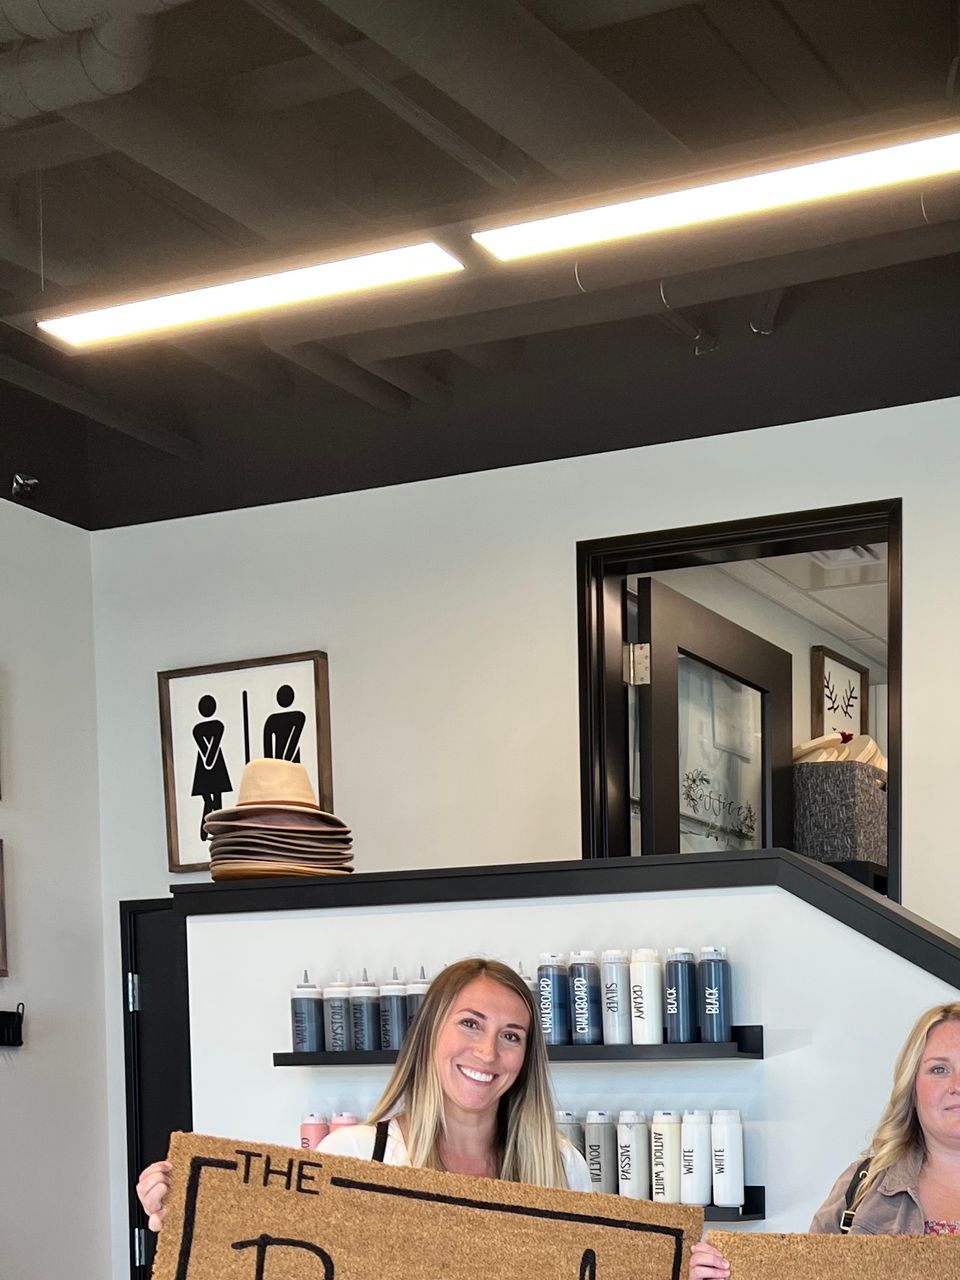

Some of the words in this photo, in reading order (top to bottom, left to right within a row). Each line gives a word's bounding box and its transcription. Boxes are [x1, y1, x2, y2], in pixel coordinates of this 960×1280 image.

[540, 977, 553, 1033] CHALKBOARD
[574, 977, 588, 1033] CHALKBOARD
[605, 982, 619, 1013] SILVER
[632, 984, 645, 1020] CREAMY
[666, 986, 678, 1014] BLACK
[705, 986, 719, 1014] BLACK
[295, 1011, 308, 1045] WALNUT
[351, 1003, 365, 1051] PROVINCIAL
[381, 1008, 391, 1048] GRAPHITE
[619, 1143, 632, 1180] PASSIVE
[653, 1132, 665, 1167] ANTIQUE
[683, 1148, 694, 1175] WHITE
[714, 1148, 725, 1175] WHITE
[235, 1149, 325, 1196] THE
[654, 1170, 665, 1196] WHITE
